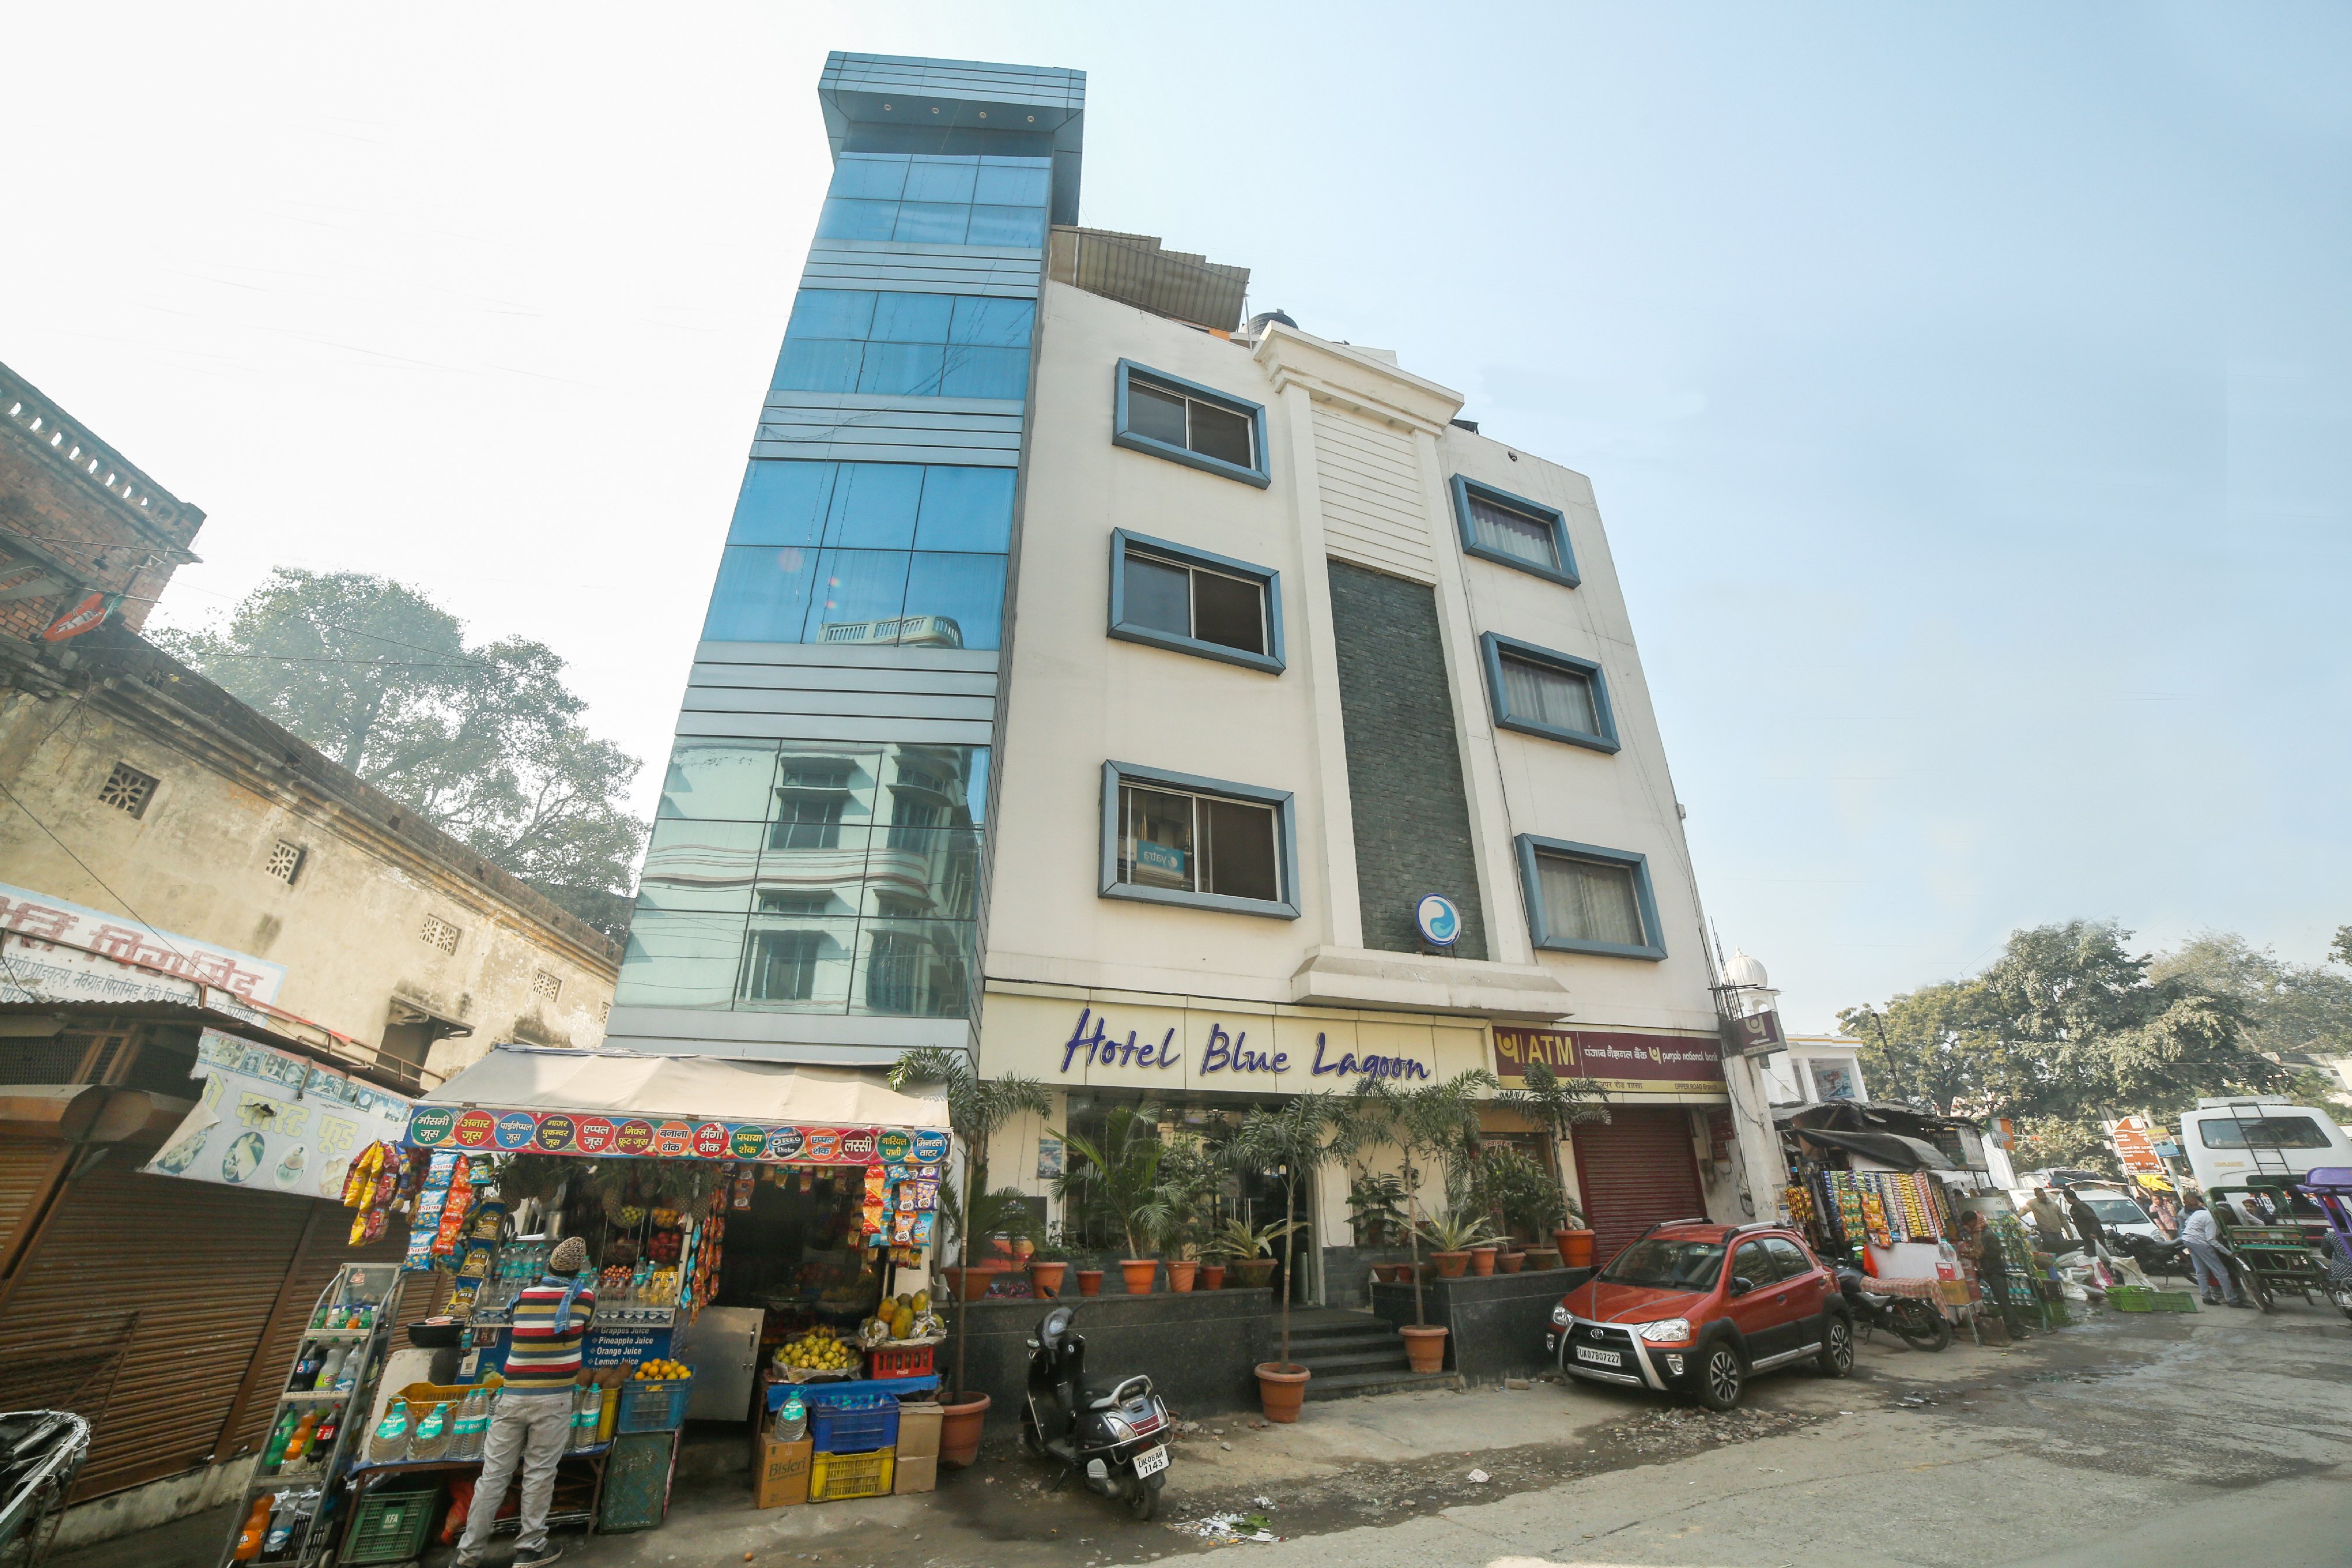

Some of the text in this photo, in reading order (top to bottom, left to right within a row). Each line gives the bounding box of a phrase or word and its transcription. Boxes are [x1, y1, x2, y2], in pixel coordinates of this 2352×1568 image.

[1060, 1007, 1431, 1081] Hotel Blue Lagoon
[1528, 1034, 1575, 1066] ATM
[1584, 1045, 1606, 1058] पंजाब
[1634, 1046, 1647, 1059] बैंक
[1663, 1051, 1718, 1063] punjab national bank
[1614, 1080, 1625, 1088] रोड
[418, 1114, 450, 1126] मौसमी
[461, 1118, 491, 1128] अनार
[420, 1129, 440, 1142] जूस
[542, 1129, 569, 1138] चुकन्दर
[583, 1125, 610, 1135] एप्पल
[624, 1125, 647, 1136] मिक्स
[659, 1129, 689, 1138] बनाना
[462, 1130, 483, 1143] जूस
[506, 1133, 521, 1144] जूस
[736, 1133, 763, 1142] पपाया
[771, 1137, 801, 1146] OREO
[882, 1135, 907, 1146] नारियल
[546, 1139, 561, 1148] जूस
[584, 1136, 604, 1149] जूस
[632, 1138, 649, 1148] जूस
[662, 1140, 682, 1153] शेक
[699, 1140, 721, 1153] शेक
[844, 1136, 873, 1152] लस्सी
[917, 1139, 943, 1147] मिनरल
[739, 1143, 757, 1154] शेक
[812, 1146, 831, 1155] शेक
[885, 1147, 901, 1156] पानी
[920, 1149, 938, 1157] वाटर
[601, 1326, 630, 1335] Grappes
[599, 1336, 633, 1346] Pineapple
[597, 1347, 623, 1356] Orange
[594, 1357, 618, 1366] Lemon
[769, 1456, 806, 1478] Bisleri
[1144, 1459, 1163, 1474] 1143
[385, 1513, 399, 1524] KFA
